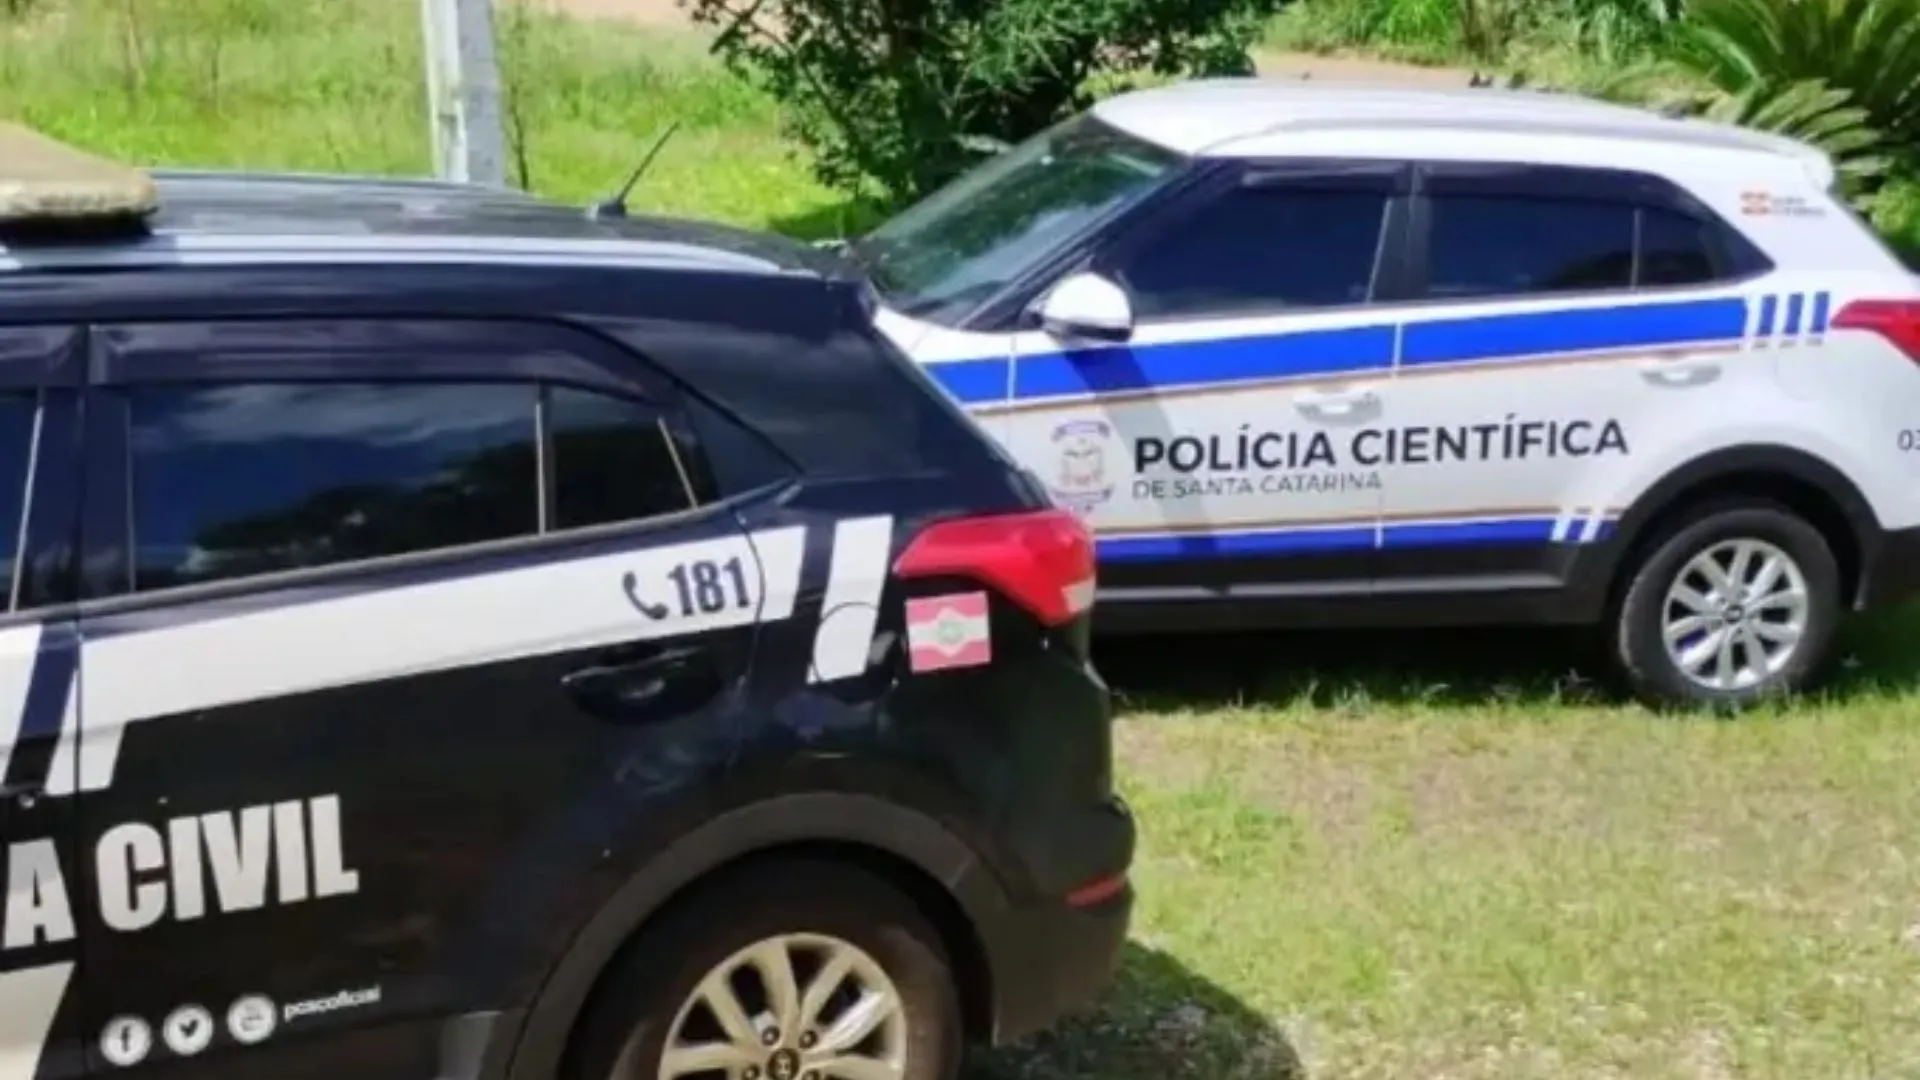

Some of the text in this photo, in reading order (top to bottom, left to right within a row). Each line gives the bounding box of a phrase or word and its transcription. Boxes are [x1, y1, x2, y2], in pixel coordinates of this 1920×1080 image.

[1134, 412, 1630, 474] POLÍCIA CIENTÍFICA
[1131, 471, 1383, 500] DE SANTA CATARINA
[667, 556, 751, 618] 181
[3, 793, 360, 950] A CIVIL
